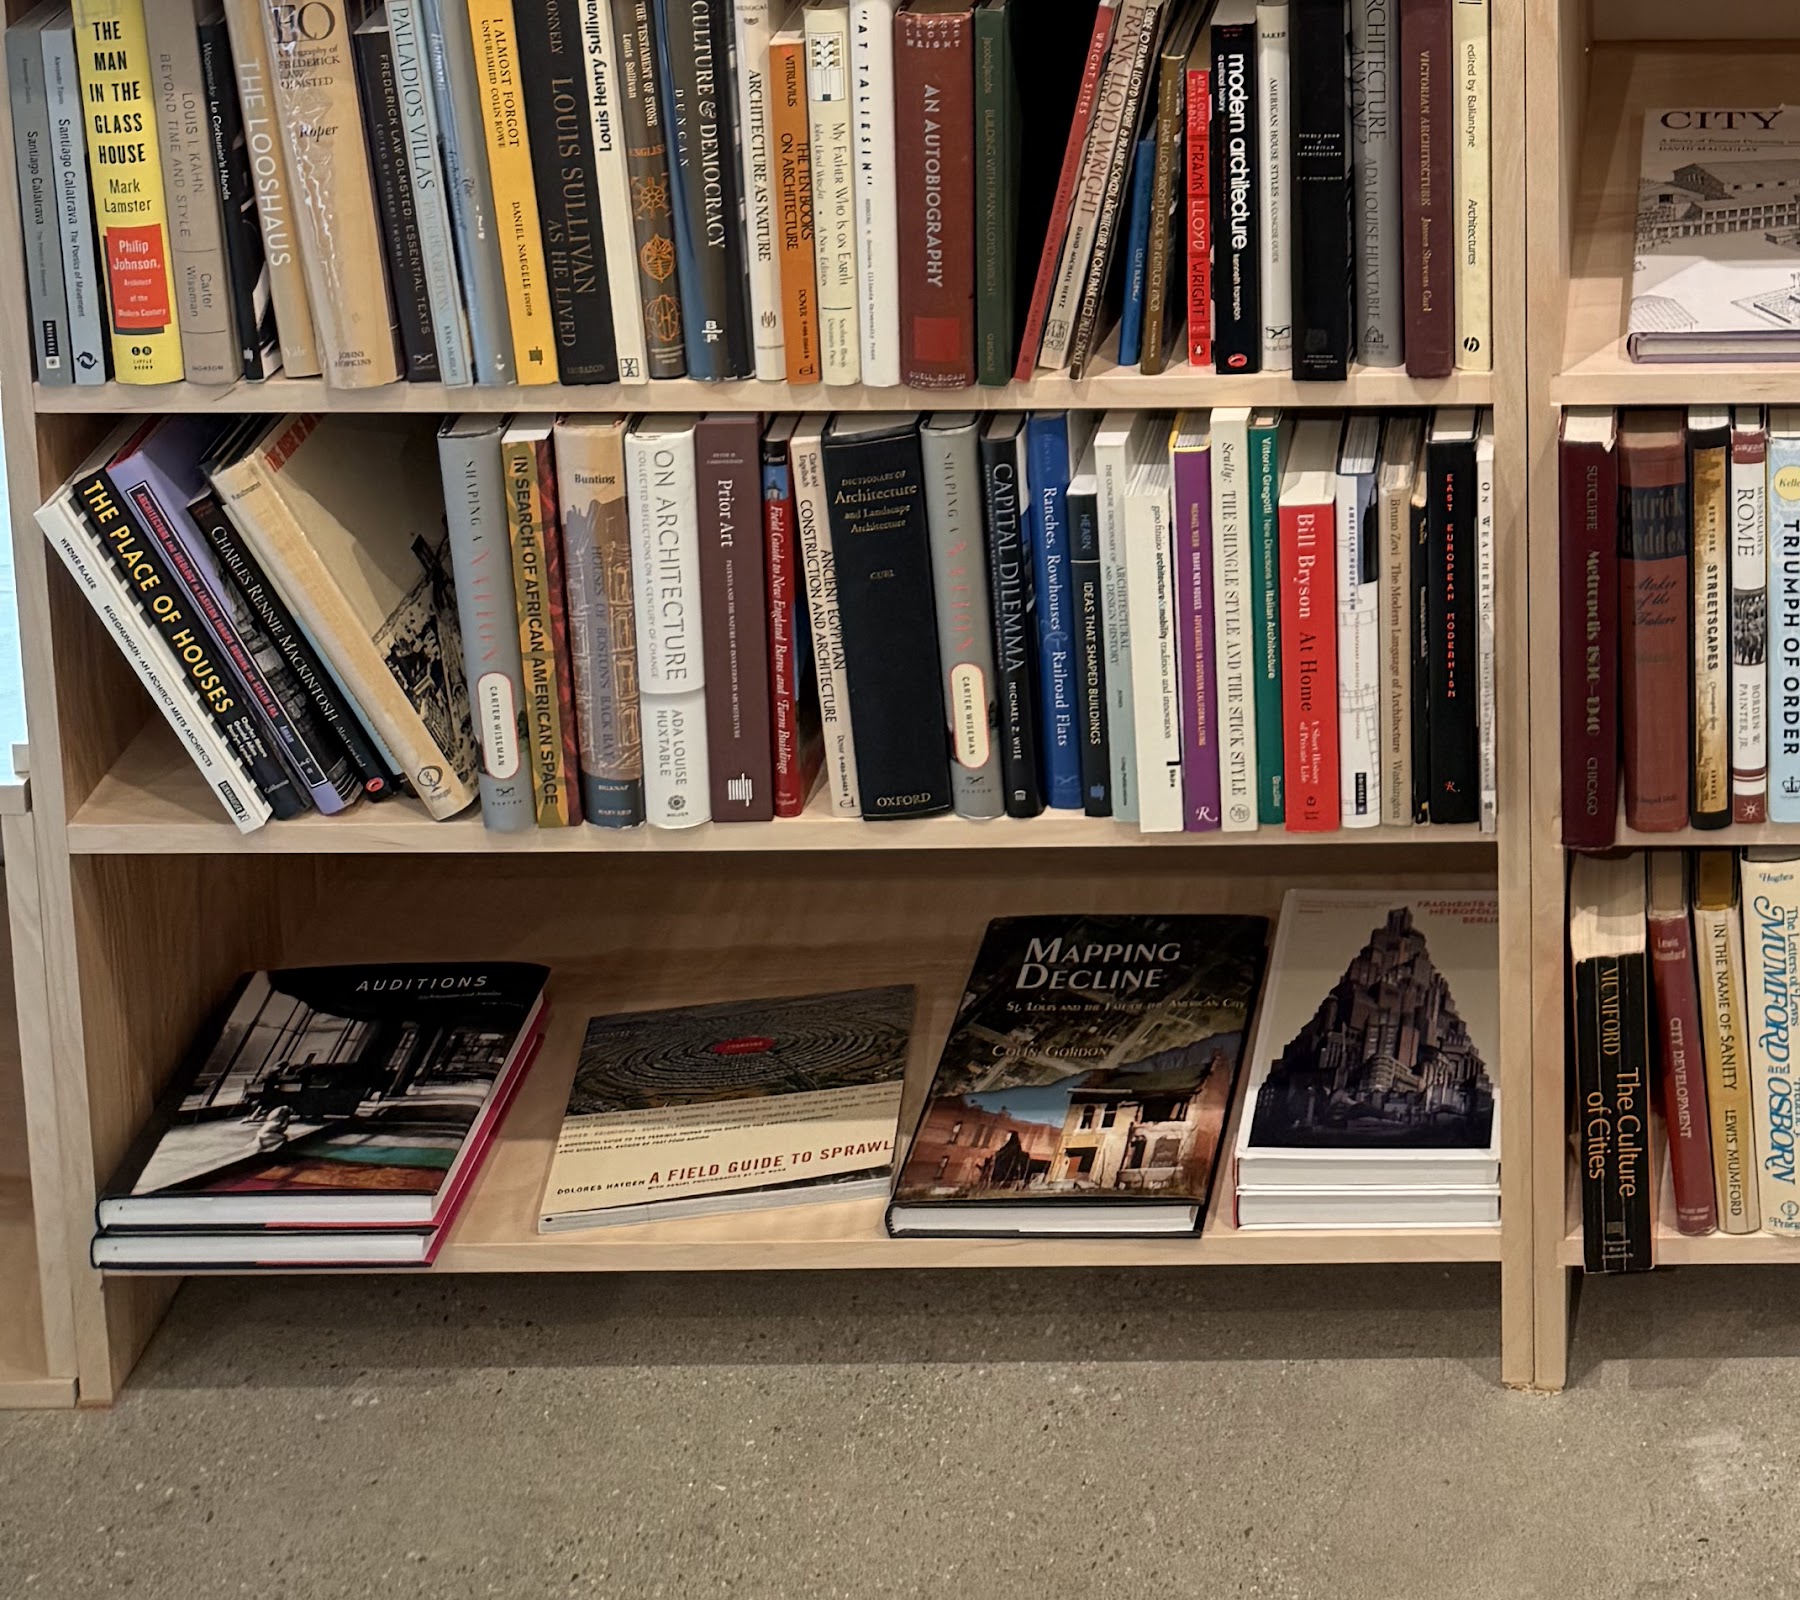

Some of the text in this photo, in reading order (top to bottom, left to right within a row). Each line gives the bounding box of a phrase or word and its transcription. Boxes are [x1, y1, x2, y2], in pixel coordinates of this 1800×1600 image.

[93, 21, 122, 40] THE
[94, 51, 128, 71] MAN
[89, 81, 140, 101] IN THE
[95, 113, 143, 135] GLASS
[1660, 110, 1782, 129] CITY
[98, 143, 145, 165] HOUSE
[1228, 53, 1248, 249] modern architecture
[923, 86, 942, 287] AN AUTOBIOGRAPHY
[119, 240, 148, 255] Philip
[655, 449, 686, 679] ON ARCHITECTURE
[1294, 513, 1316, 618] Bill Bryson
[82, 480, 233, 714] THE PLACE OF HOUSES
[877, 791, 931, 808] OXFORD
[1024, 937, 1180, 963] MAPPING
[355, 975, 489, 992] AUDITIONS
[1015, 963, 1161, 989] DECLINE
